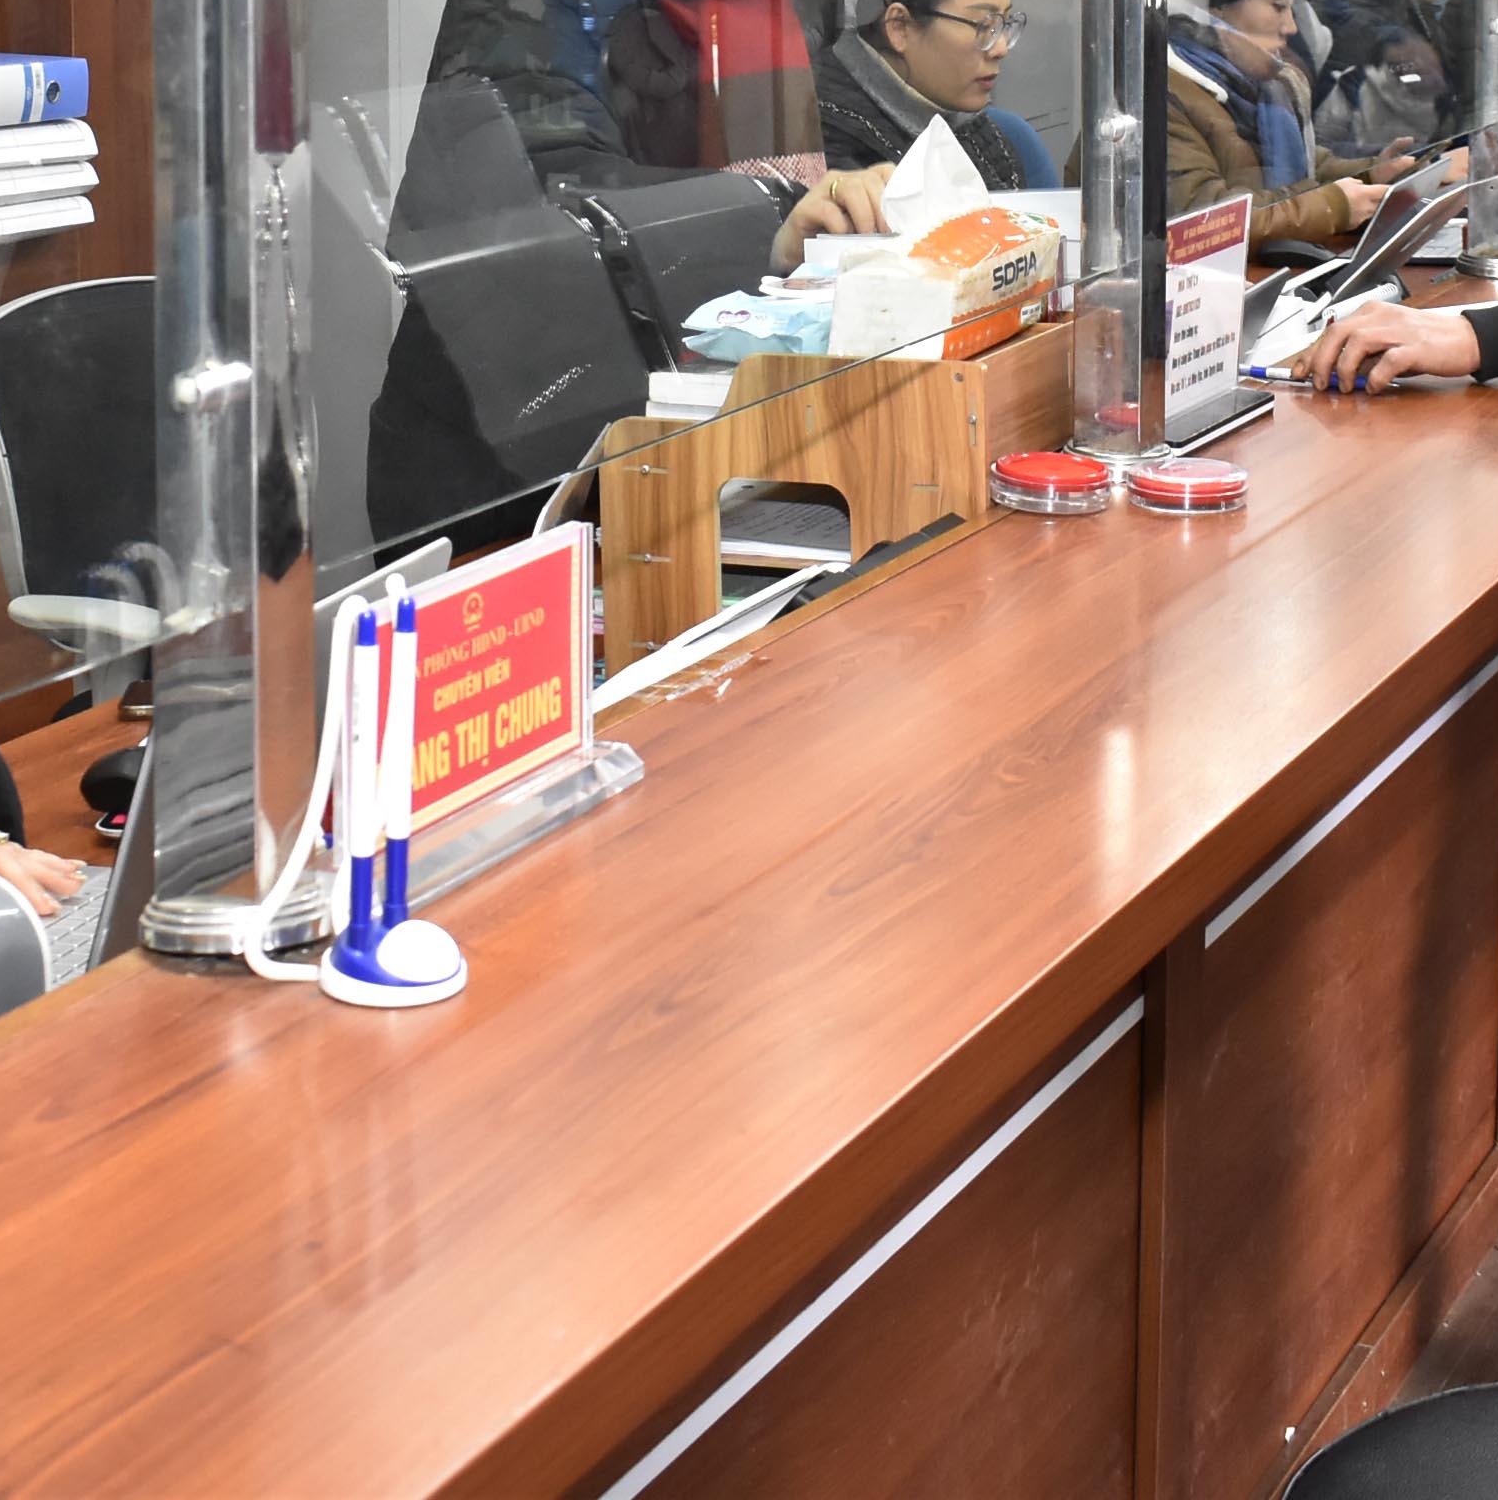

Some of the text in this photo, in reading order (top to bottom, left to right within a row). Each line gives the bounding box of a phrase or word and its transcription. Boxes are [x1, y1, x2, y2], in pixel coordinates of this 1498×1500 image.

[484, 657, 511, 690] VIÊN
[455, 711, 490, 768] THỊ
[495, 676, 563, 749] CHUNG
